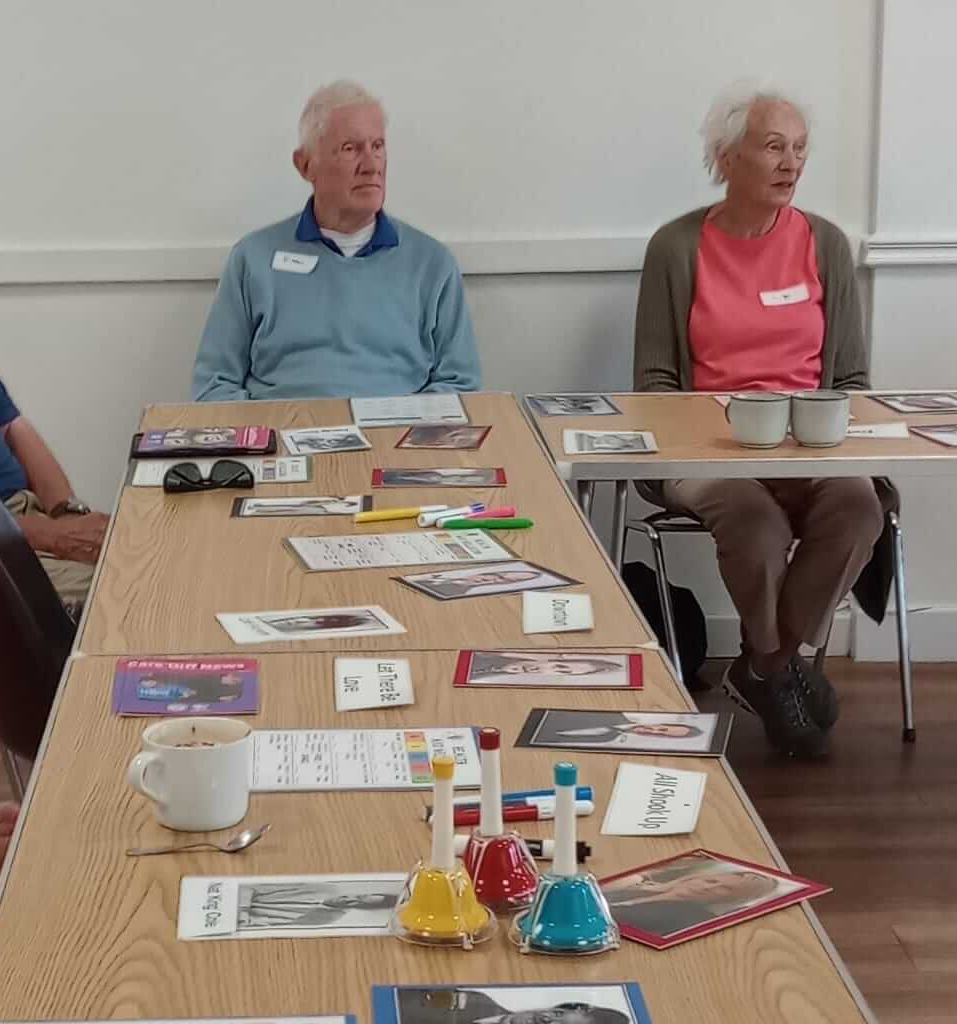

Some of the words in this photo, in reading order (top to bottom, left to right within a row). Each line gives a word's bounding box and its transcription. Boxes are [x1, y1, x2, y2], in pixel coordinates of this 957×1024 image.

[378, 662, 396, 673] Let
[379, 673, 398, 692] There
[653, 772, 678, 787] All
[645, 788, 676, 815] Shook
[637, 816, 669, 829] Up
[202, 895, 222, 910] King
